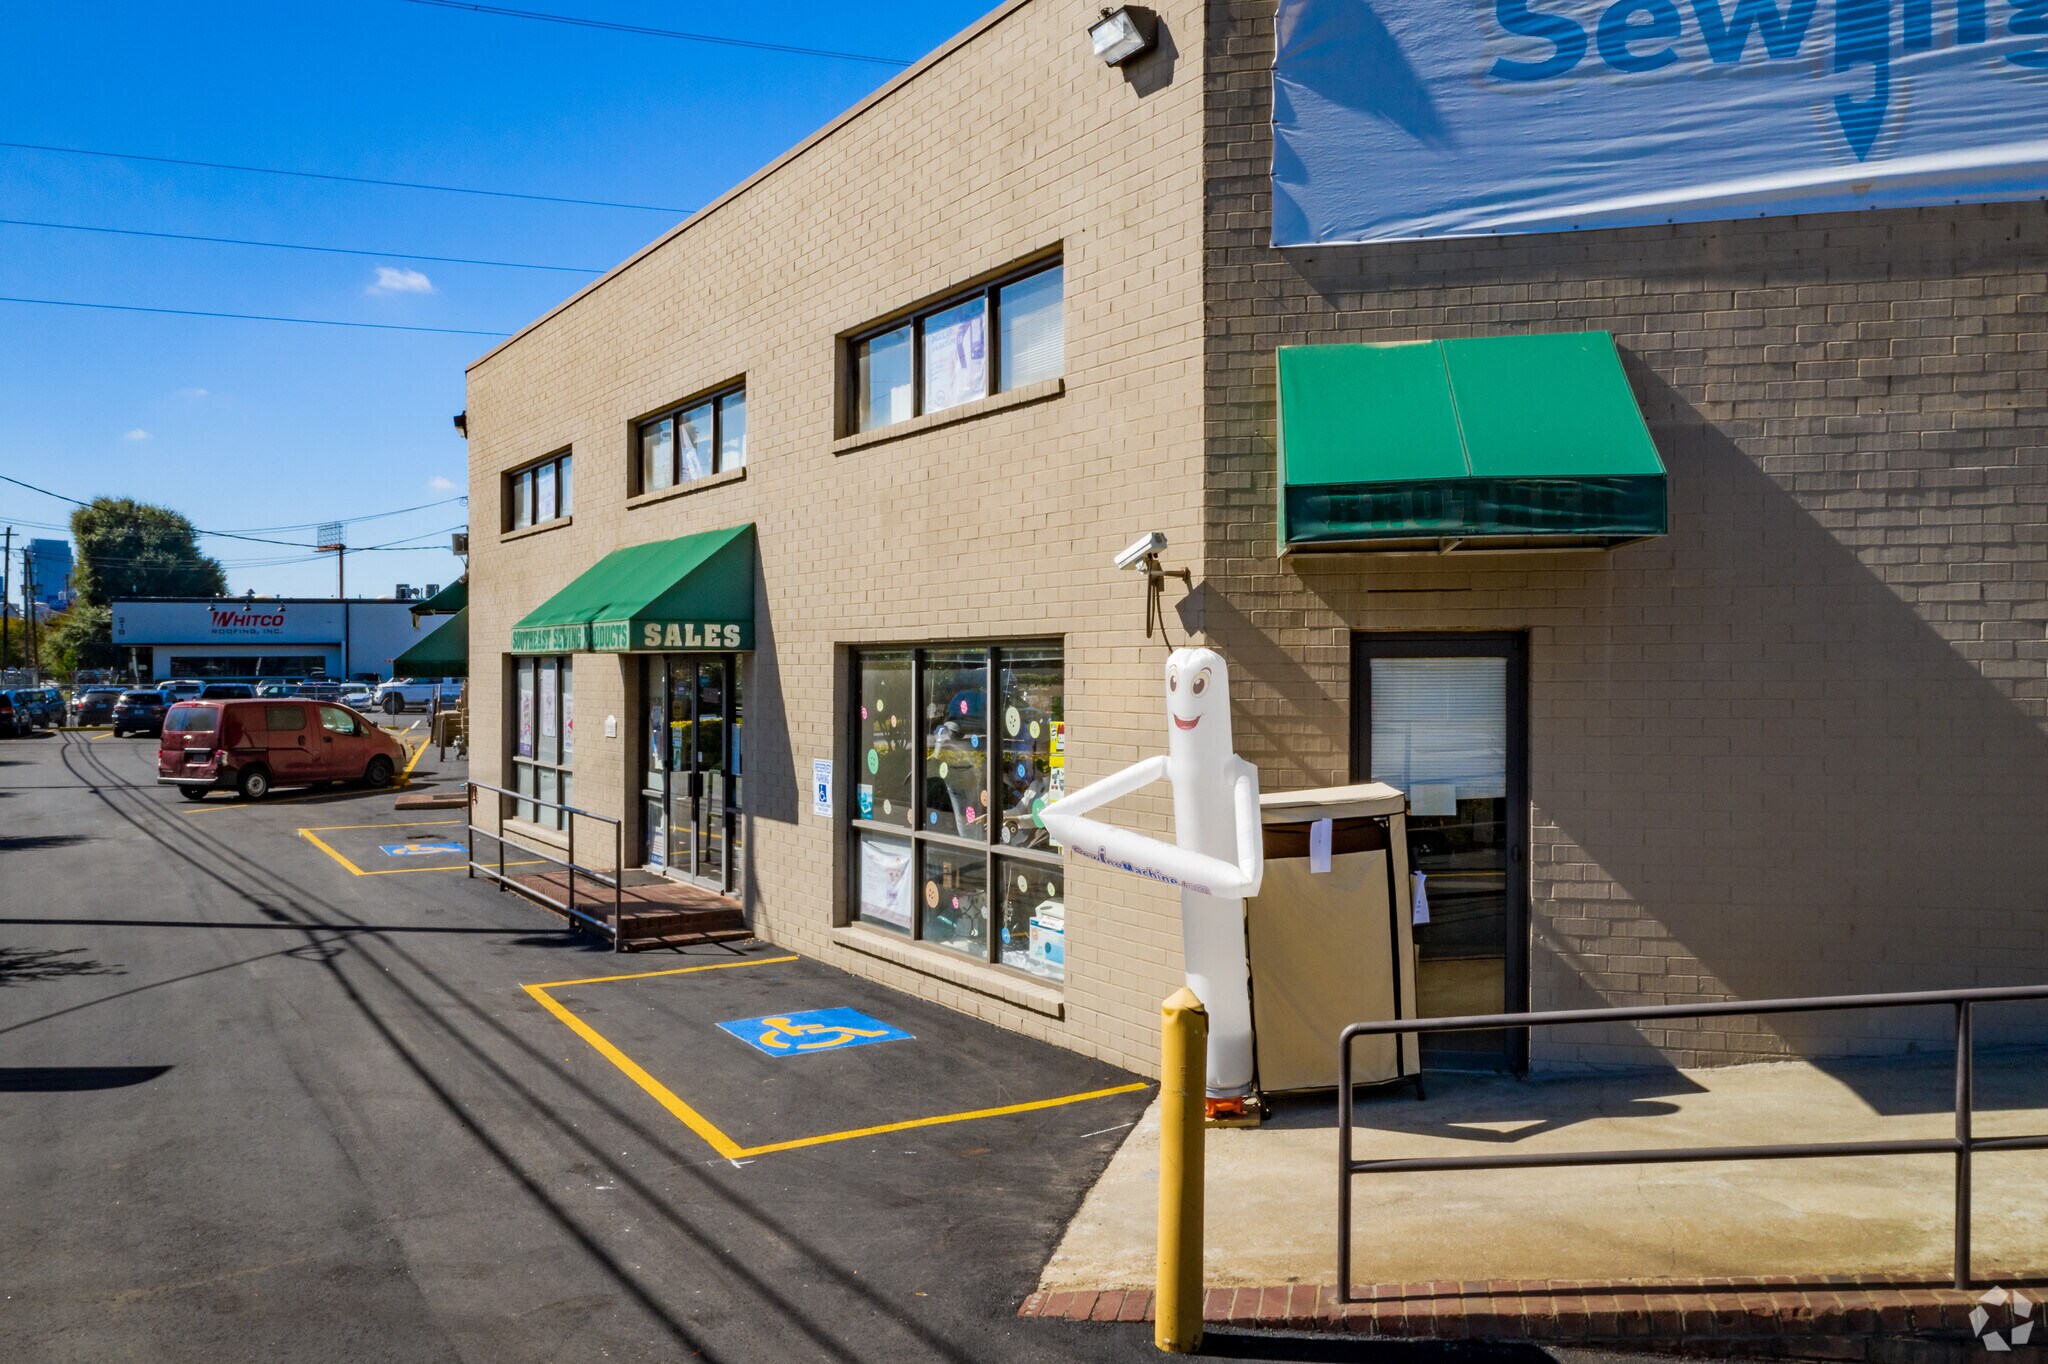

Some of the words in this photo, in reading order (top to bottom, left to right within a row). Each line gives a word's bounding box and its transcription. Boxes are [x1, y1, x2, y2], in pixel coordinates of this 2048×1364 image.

[212, 611, 284, 627] WHITCO
[512, 629, 551, 650] SOUTHEAST
[553, 627, 582, 649] SEWING
[584, 624, 628, 649] PODUCTS
[644, 623, 741, 648] SALES
